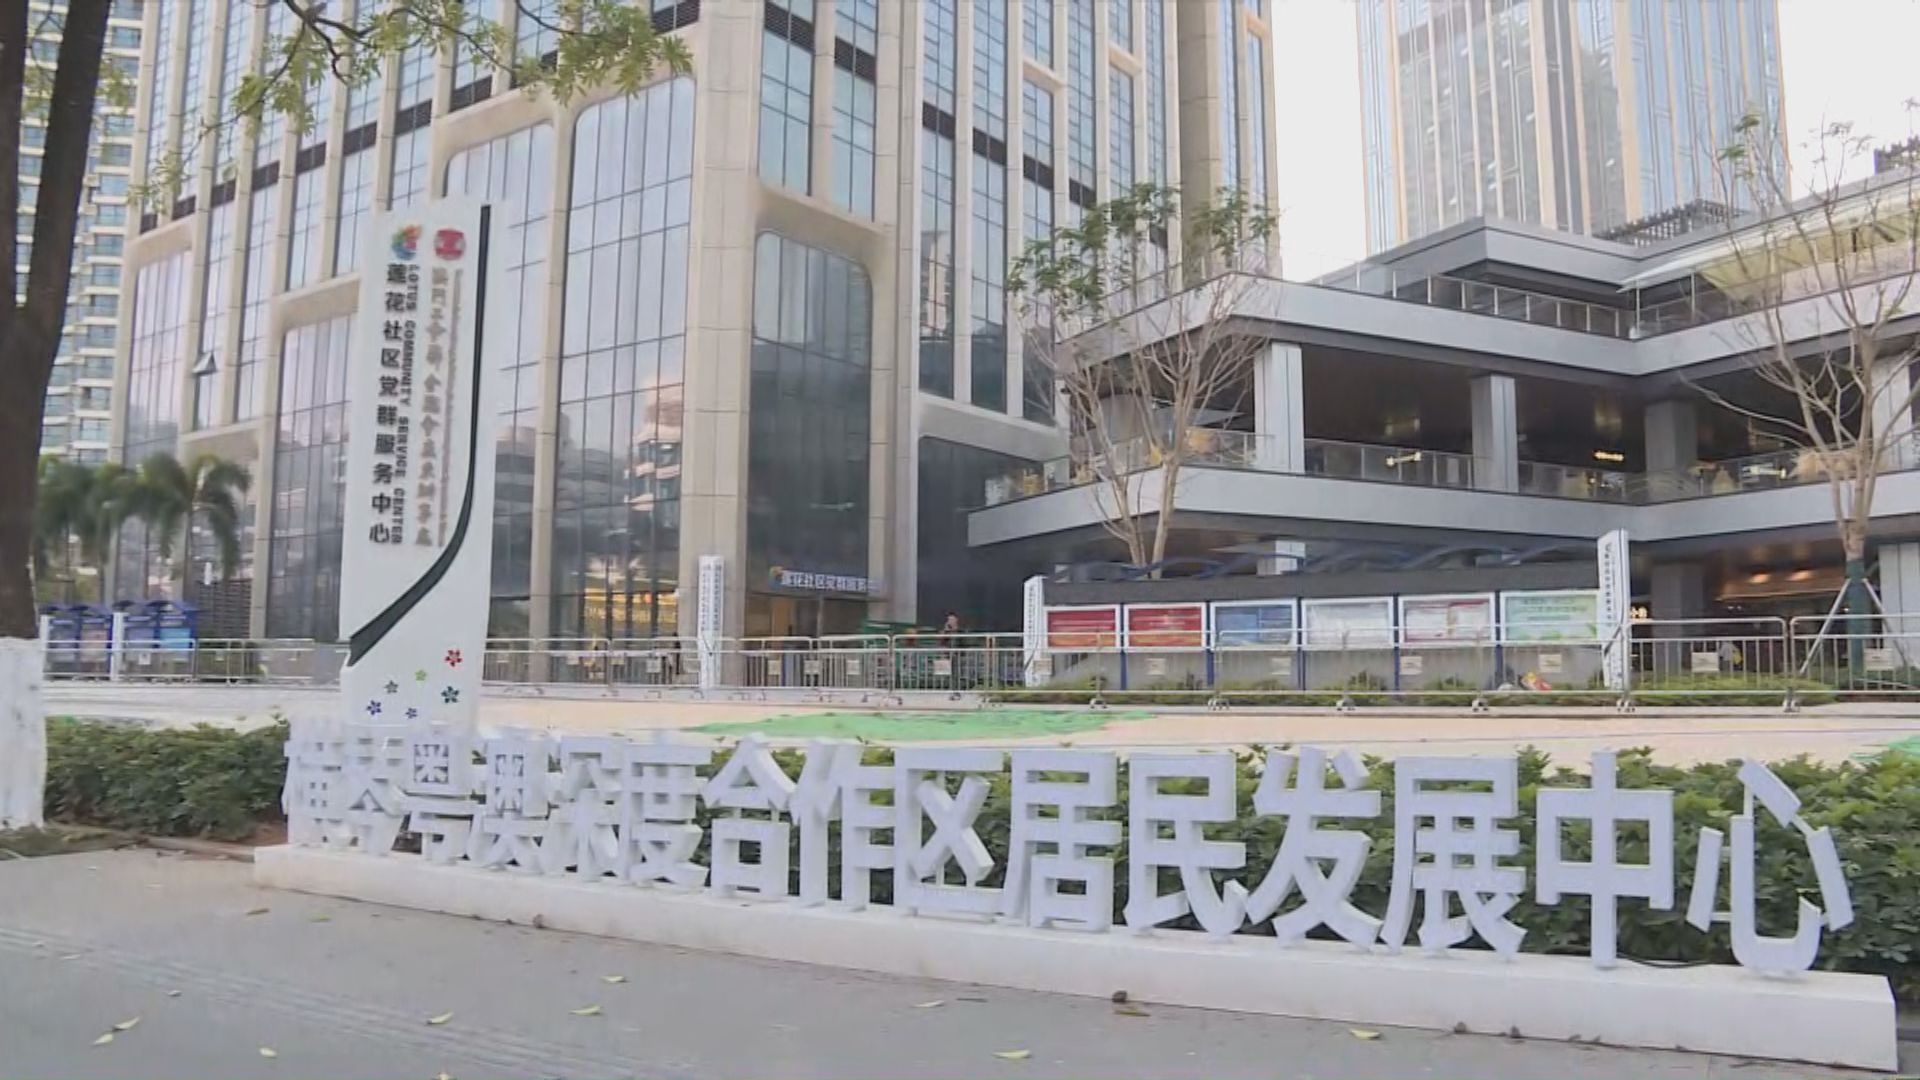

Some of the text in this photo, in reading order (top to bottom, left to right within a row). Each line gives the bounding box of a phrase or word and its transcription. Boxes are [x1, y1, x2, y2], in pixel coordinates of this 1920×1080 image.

[369, 263, 407, 544] 莲花社区党群服务中心
[391, 264, 420, 544] LOTUS COMMUNITY SERVICE CENTER
[281, 724, 1854, 974] 横琴粤澳深度合作区居民发展中心
